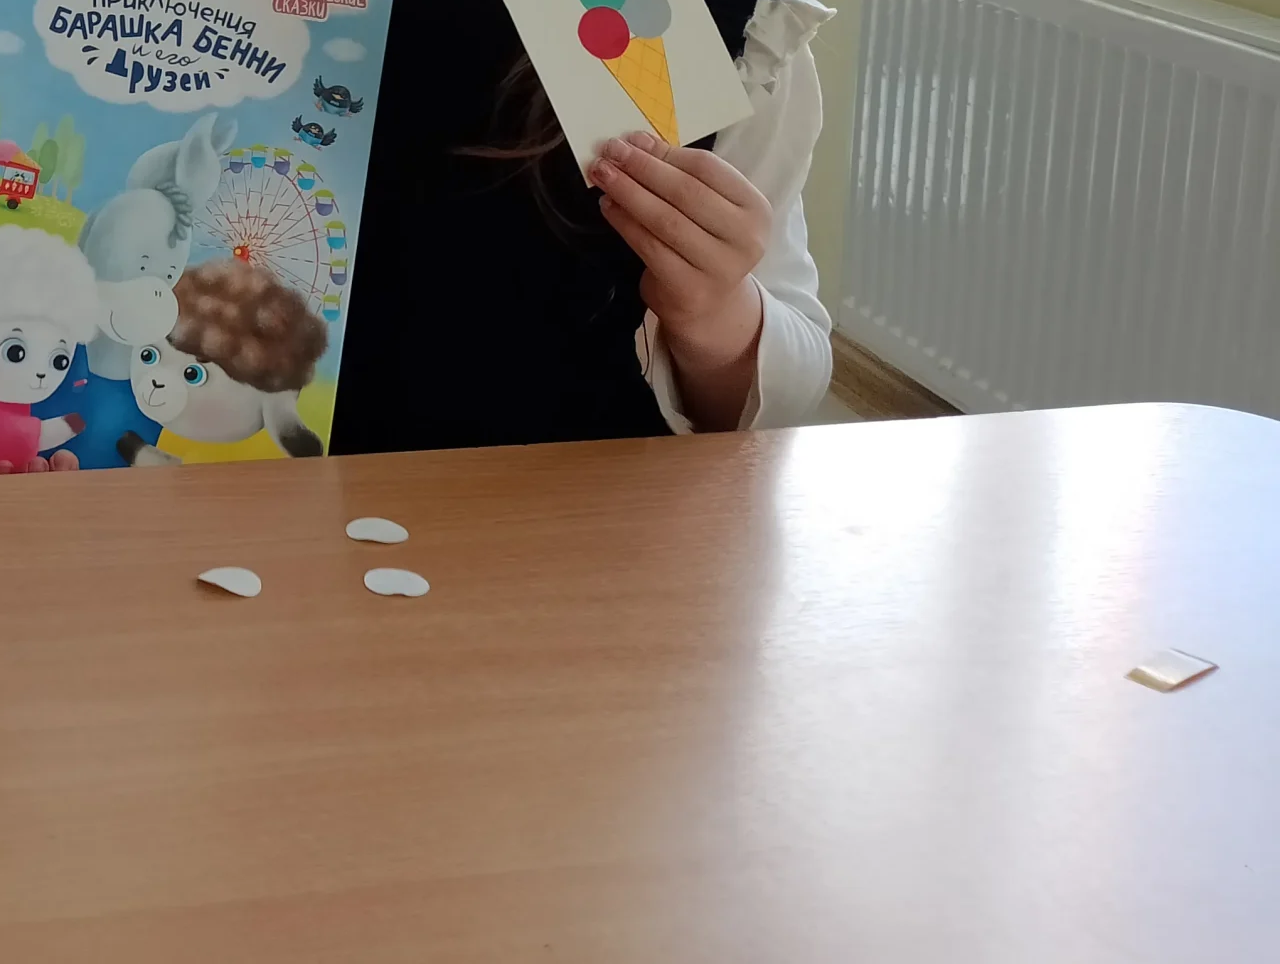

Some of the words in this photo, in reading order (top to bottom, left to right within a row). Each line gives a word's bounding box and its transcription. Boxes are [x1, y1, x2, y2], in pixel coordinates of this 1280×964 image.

[48, 5, 183, 47] БАРАШКА
[192, 24, 287, 84] БЕННИ
[131, 43, 152, 57] и
[155, 48, 202, 67] его
